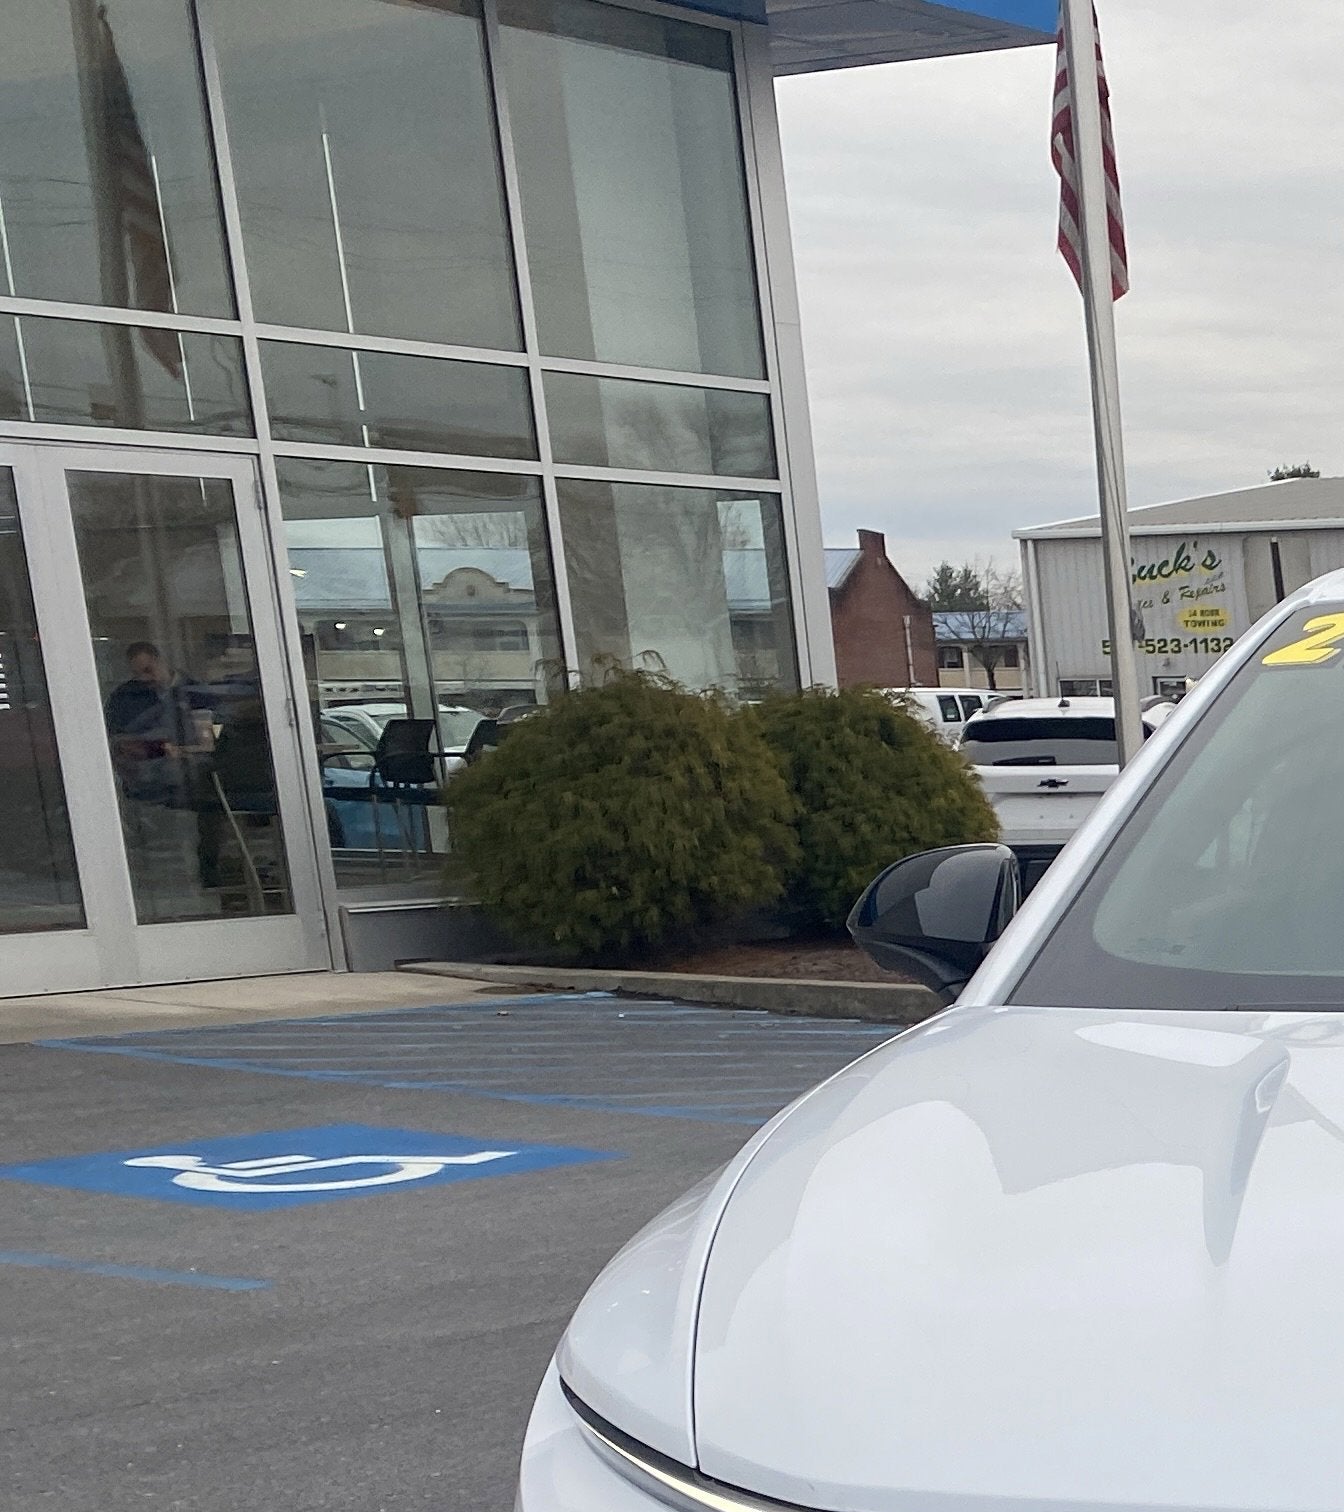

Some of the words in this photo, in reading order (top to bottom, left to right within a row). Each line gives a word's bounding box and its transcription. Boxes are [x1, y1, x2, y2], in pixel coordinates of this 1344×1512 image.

[1130, 540, 1222, 585] uck's
[1161, 590, 1170, 604] &
[1178, 582, 1226, 601] Repairs
[1183, 619, 1225, 628] TOWING
[1101, 637, 1234, 655] 5-523-1132
